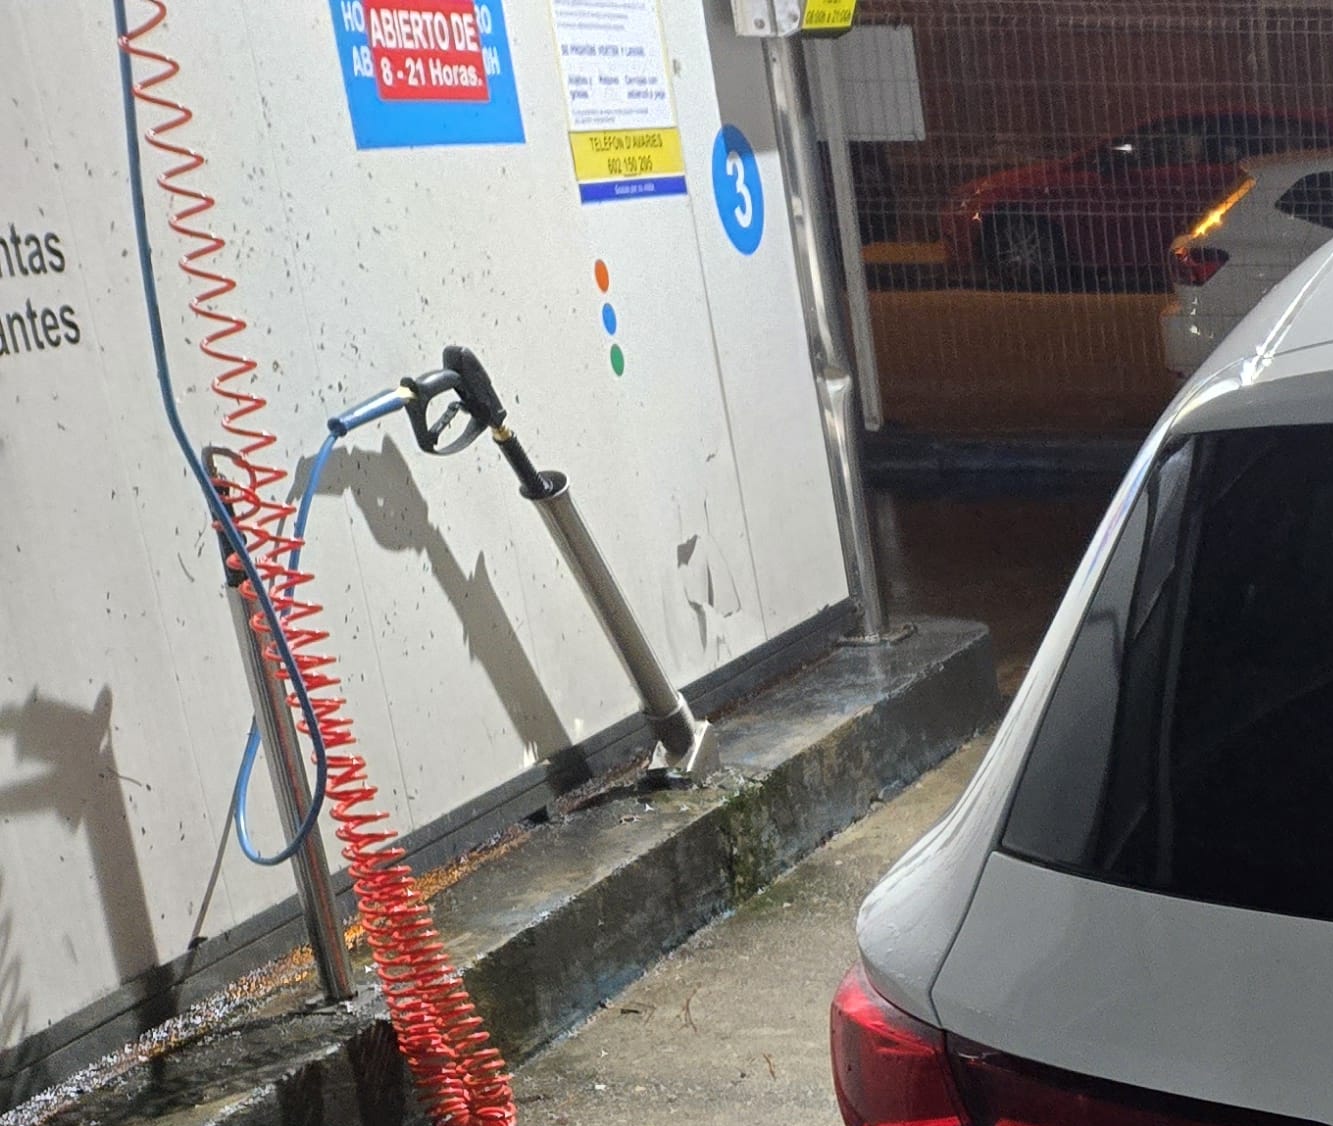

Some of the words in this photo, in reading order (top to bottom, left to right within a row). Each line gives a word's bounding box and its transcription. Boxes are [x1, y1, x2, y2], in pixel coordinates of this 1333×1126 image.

[369, 8, 449, 50] ABIERTO
[450, 12, 479, 52] DE
[380, 56, 393, 87] 8
[405, 57, 426, 86] 21
[428, 58, 483, 87] Horas.
[725, 151, 753, 228] 3
